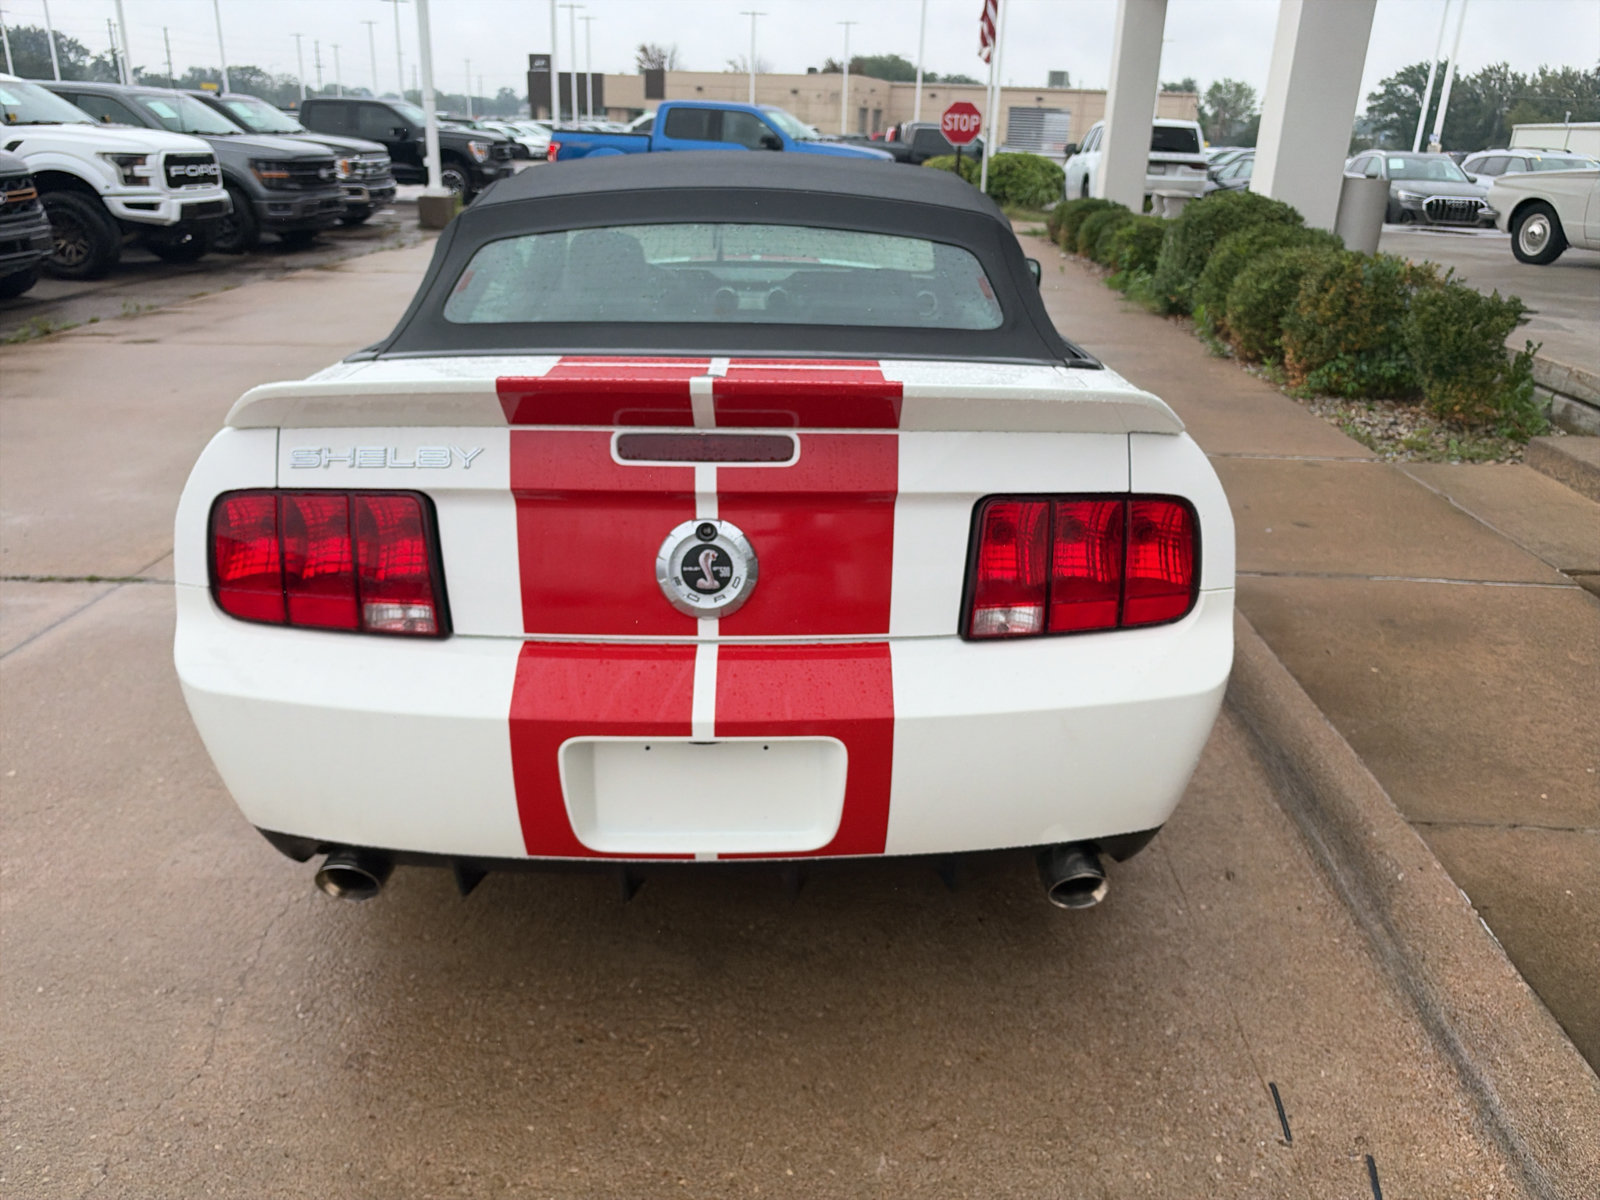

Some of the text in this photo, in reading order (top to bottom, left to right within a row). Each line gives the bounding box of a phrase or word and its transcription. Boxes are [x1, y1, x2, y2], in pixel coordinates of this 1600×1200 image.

[943, 113, 981, 132] STOP
[169, 163, 220, 177] FORD
[289, 446, 485, 469] SHELBY
